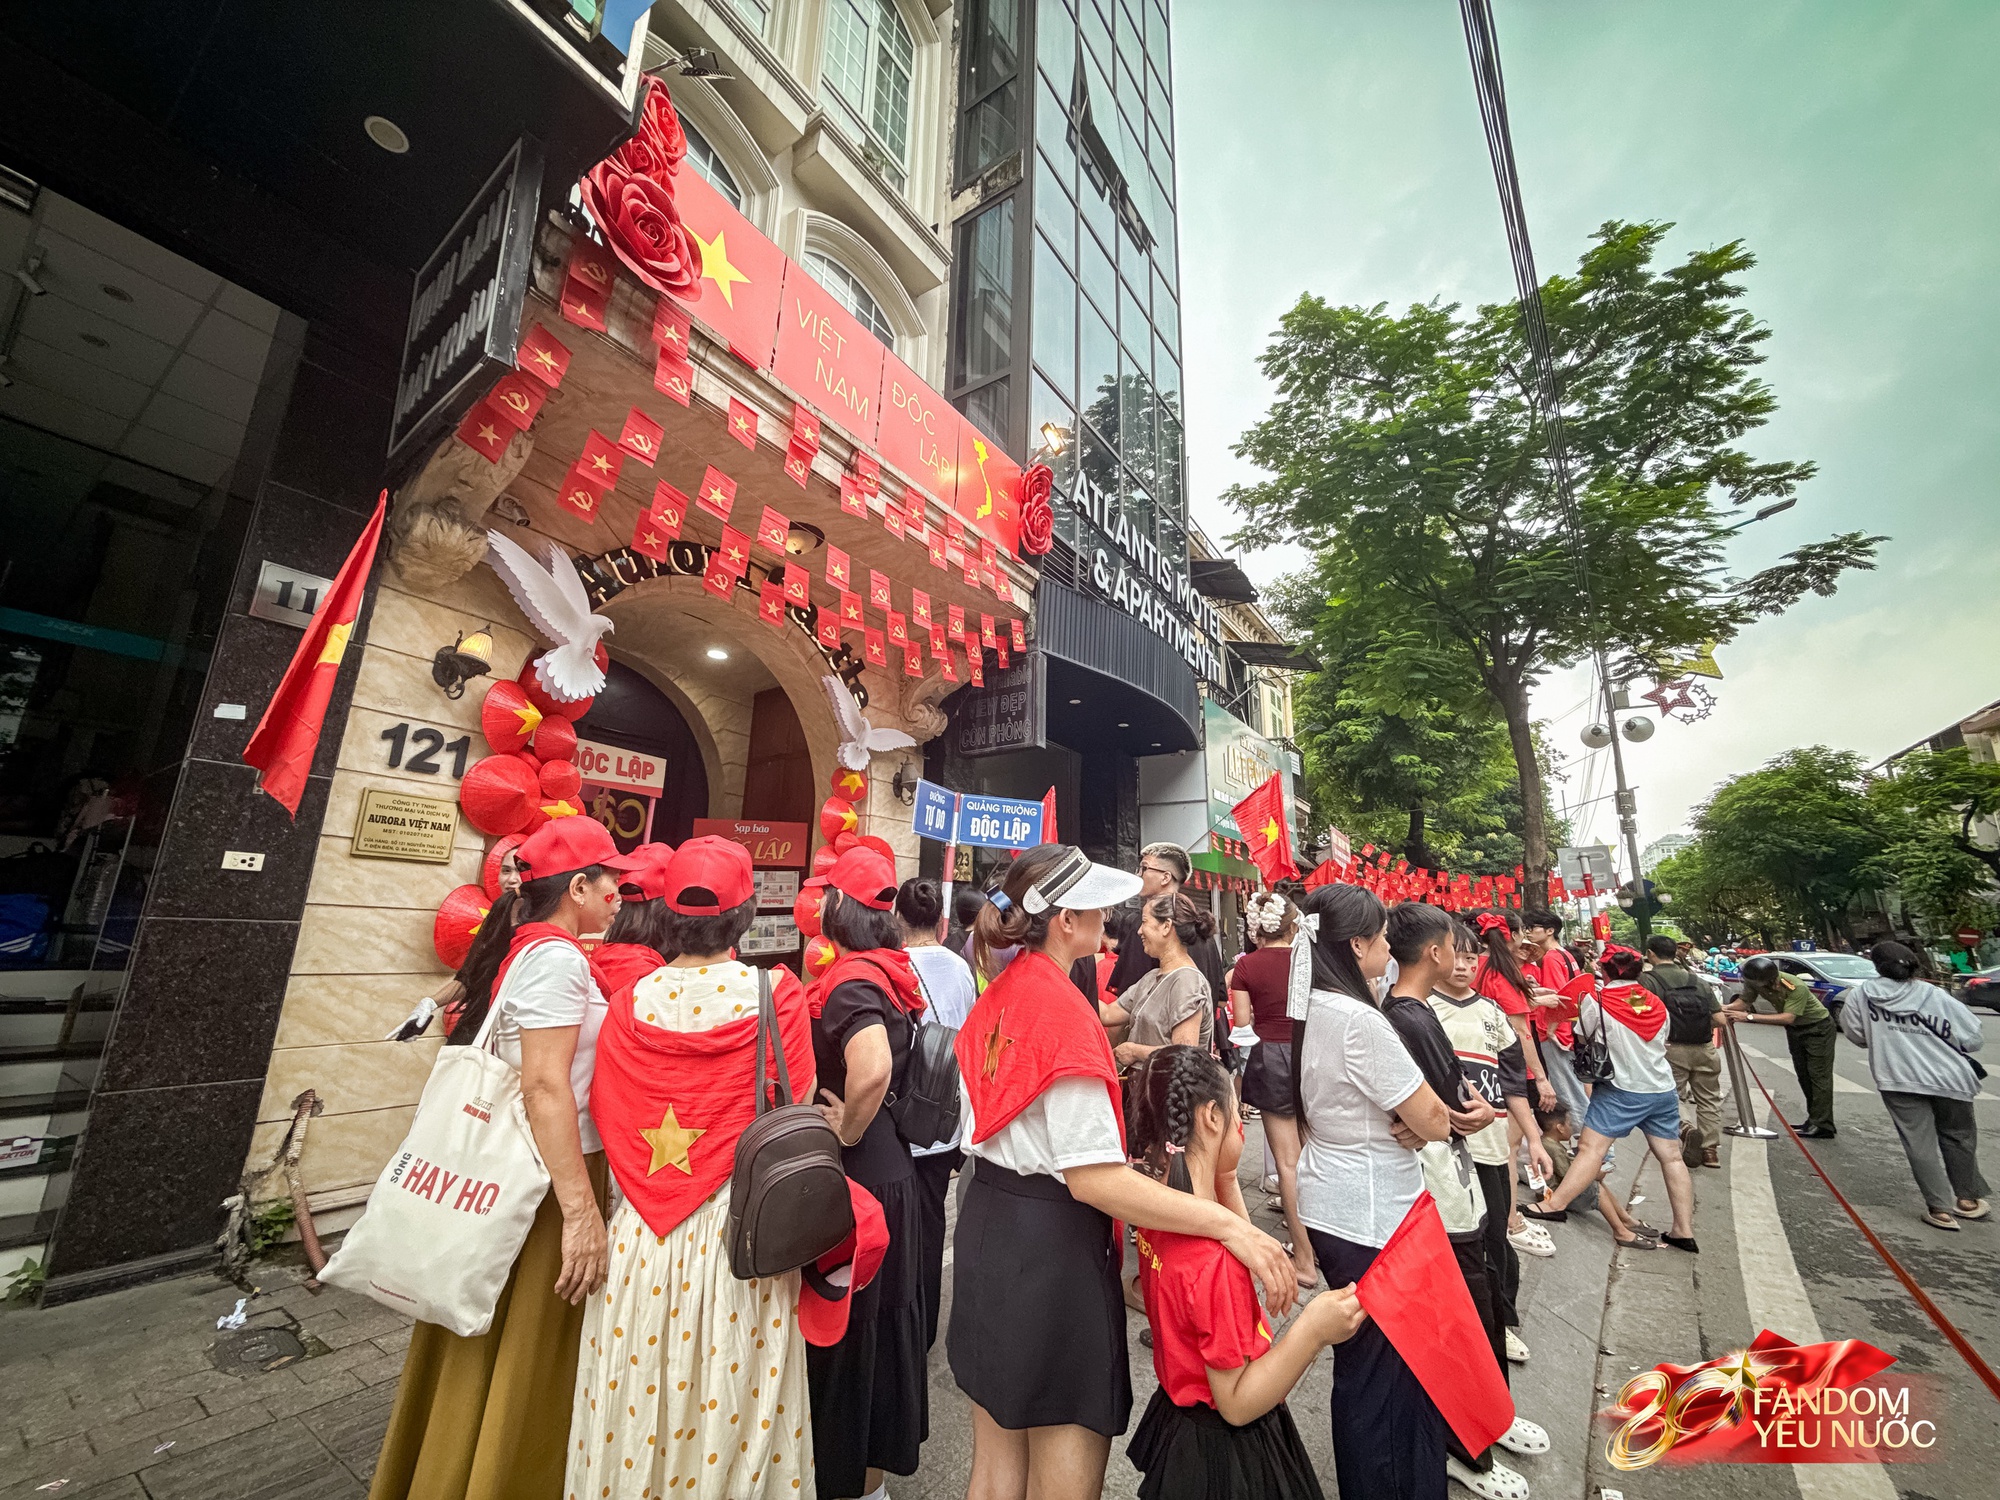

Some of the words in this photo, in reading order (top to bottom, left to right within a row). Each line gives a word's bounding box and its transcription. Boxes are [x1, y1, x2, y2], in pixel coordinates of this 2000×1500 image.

[796, 297, 847, 359] VIỆT
[815, 357, 869, 422] NAM
[892, 381, 936, 436] ĐỘC
[919, 437, 951, 479] LẬP
[1072, 470, 1172, 592] ATLANTIS
[1177, 574, 1223, 646] MOTEL
[1094, 548, 1109, 591] &
[1000, 691, 1027, 716] ĐẸP
[962, 722, 986, 747] CÒN
[988, 716, 1032, 744] PHÒNG
[381, 722, 471, 780] 121
[615, 755, 656, 783] LẬP
[375, 803, 403, 812] THƯƠNG
[392, 799, 410, 807] CÔNG
[966, 800, 1000, 813] QUẢNG
[1002, 803, 1038, 817] TRƯỜNG
[368, 814, 406, 827] AURORA
[409, 818, 429, 831] VIỆT
[430, 822, 451, 832] NAM
[734, 822, 751, 834] Sạp
[752, 823, 770, 833] báo
[935, 808, 946, 830] DO
[970, 813, 1000, 842] ĐỘC
[1003, 817, 1031, 845] LẬP
